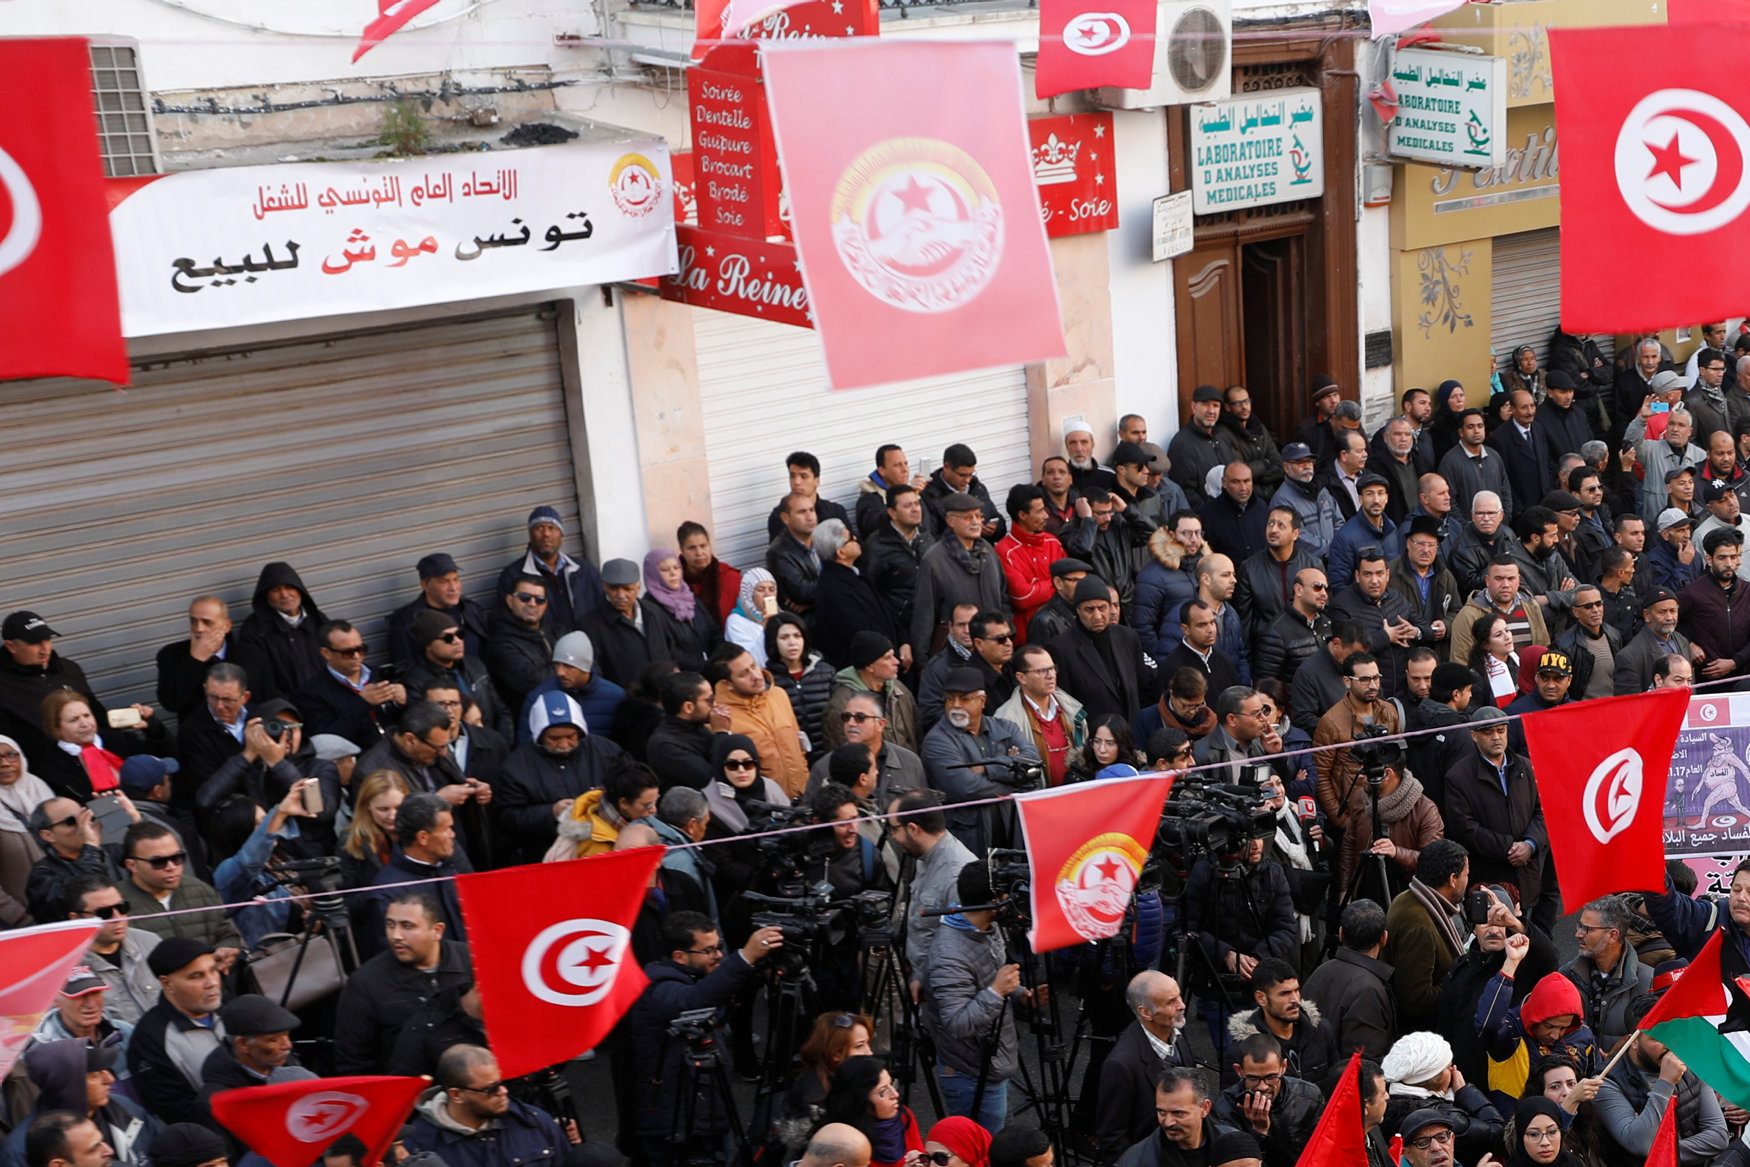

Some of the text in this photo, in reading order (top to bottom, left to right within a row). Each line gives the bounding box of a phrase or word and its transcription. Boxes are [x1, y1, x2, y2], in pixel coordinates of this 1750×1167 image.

[702, 81, 743, 103] Soirée
[1398, 94, 1461, 114] ABORATOIRE
[695, 105, 752, 129] Dentelle
[1199, 99, 1315, 139] مخبر التحاليل الطبية
[698, 131, 752, 156] Guipure
[1197, 137, 1283, 167] LABORATOIRE
[1397, 135, 1454, 152] MEDICALES
[701, 156, 753, 179] Brocart
[252, 169, 518, 220] الاتحاد العام التونسي للشغل
[708, 181, 749, 203] Brodé
[1206, 181, 1277, 205] MEDICALES
[715, 206, 745, 226] Soie
[1069, 197, 1111, 222] Soie
[171, 210, 594, 293] تونس موش للبيع
[717, 254, 810, 310] Reine
[1540, 653, 1568, 670] NYC
